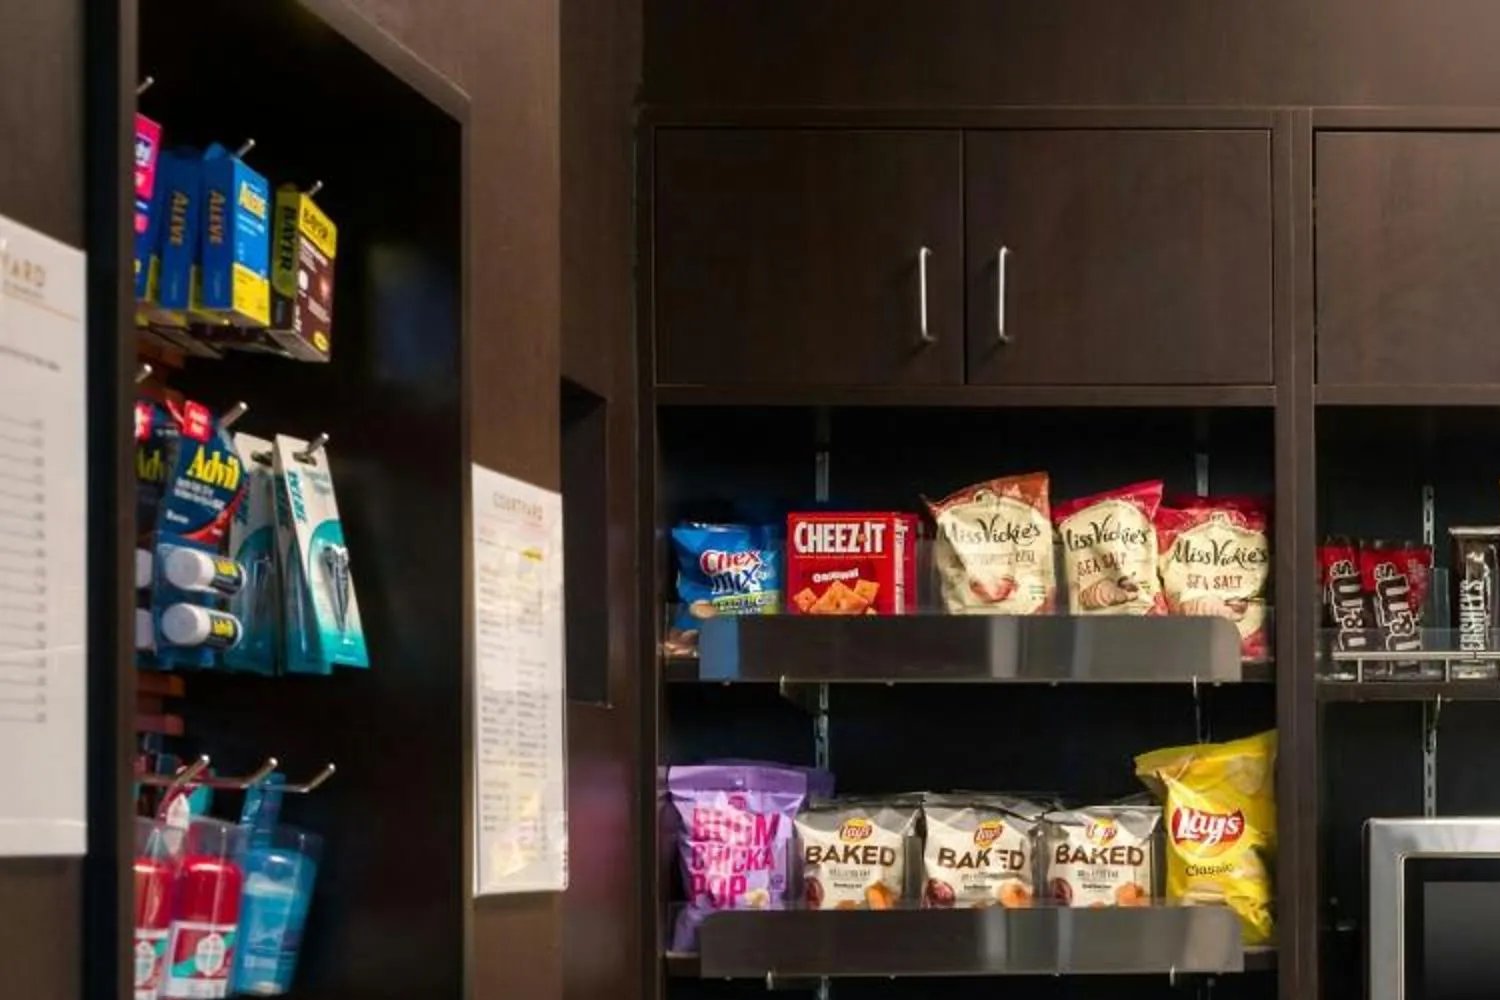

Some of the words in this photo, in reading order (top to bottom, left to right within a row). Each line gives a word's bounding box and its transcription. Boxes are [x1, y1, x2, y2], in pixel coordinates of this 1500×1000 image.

[186, 444, 240, 491] Advil
[701, 549, 762, 576] Chex
[1214, 574, 1242, 589] SALT
[1459, 578, 1485, 651] ERSHEY'S
[1175, 808, 1242, 845] Lay's
[805, 846, 896, 866] BAKED
[937, 848, 1026, 871] BAKED
[1054, 843, 1144, 866] BAKED
